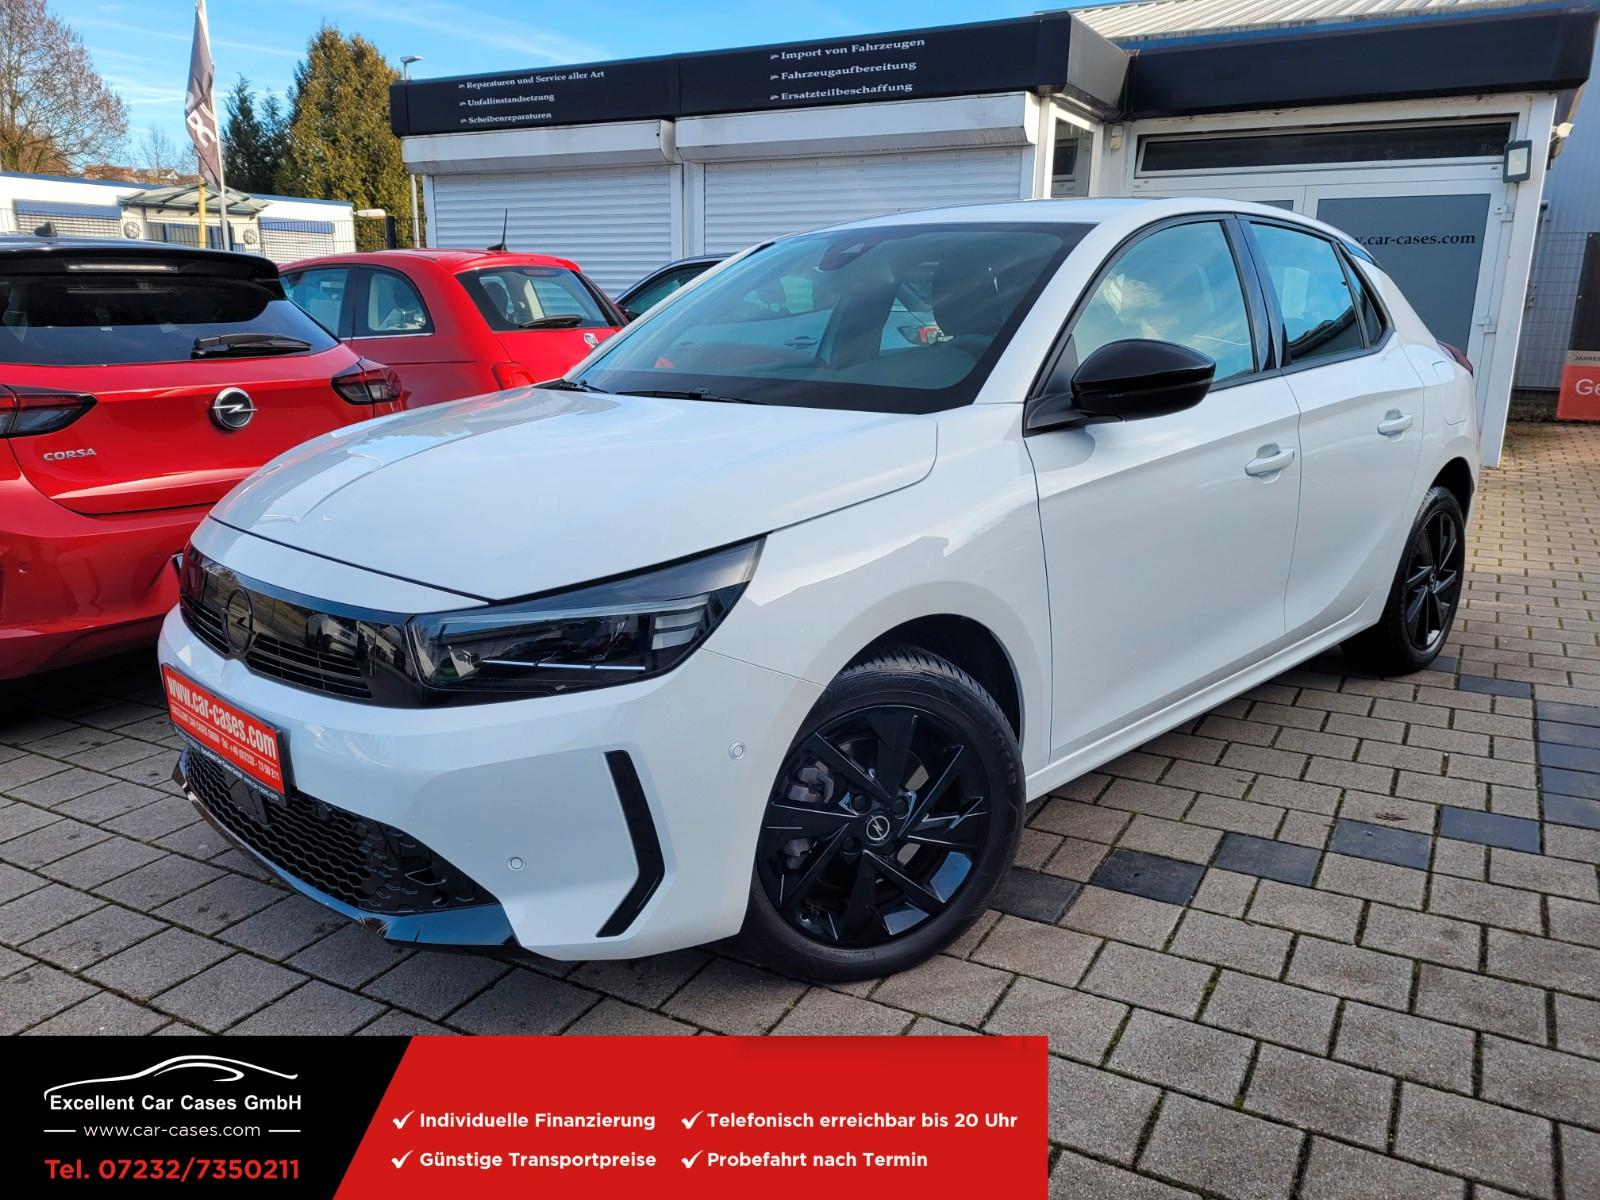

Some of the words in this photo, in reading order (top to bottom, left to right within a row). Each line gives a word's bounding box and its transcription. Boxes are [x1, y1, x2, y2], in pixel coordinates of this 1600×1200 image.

[781, 49, 821, 60] Import
[825, 47, 848, 55] von
[851, 39, 925, 53] Fahrzeugen
[466, 78, 516, 90] Reparaturen
[517, 76, 534, 85] und
[535, 73, 567, 83] Service
[568, 71, 588, 80] aller
[589, 69, 605, 78] Art
[781, 62, 917, 80] Fahrzeugaufbereitung
[467, 93, 555, 107] Unfallinstandsetzung
[781, 83, 913, 100] Ersatzteilbeschaffung
[468, 112, 552, 124] Scheibenreparaturen
[43, 448, 97, 461] CORSA
[167, 675, 276, 760] www.car-cases.com
